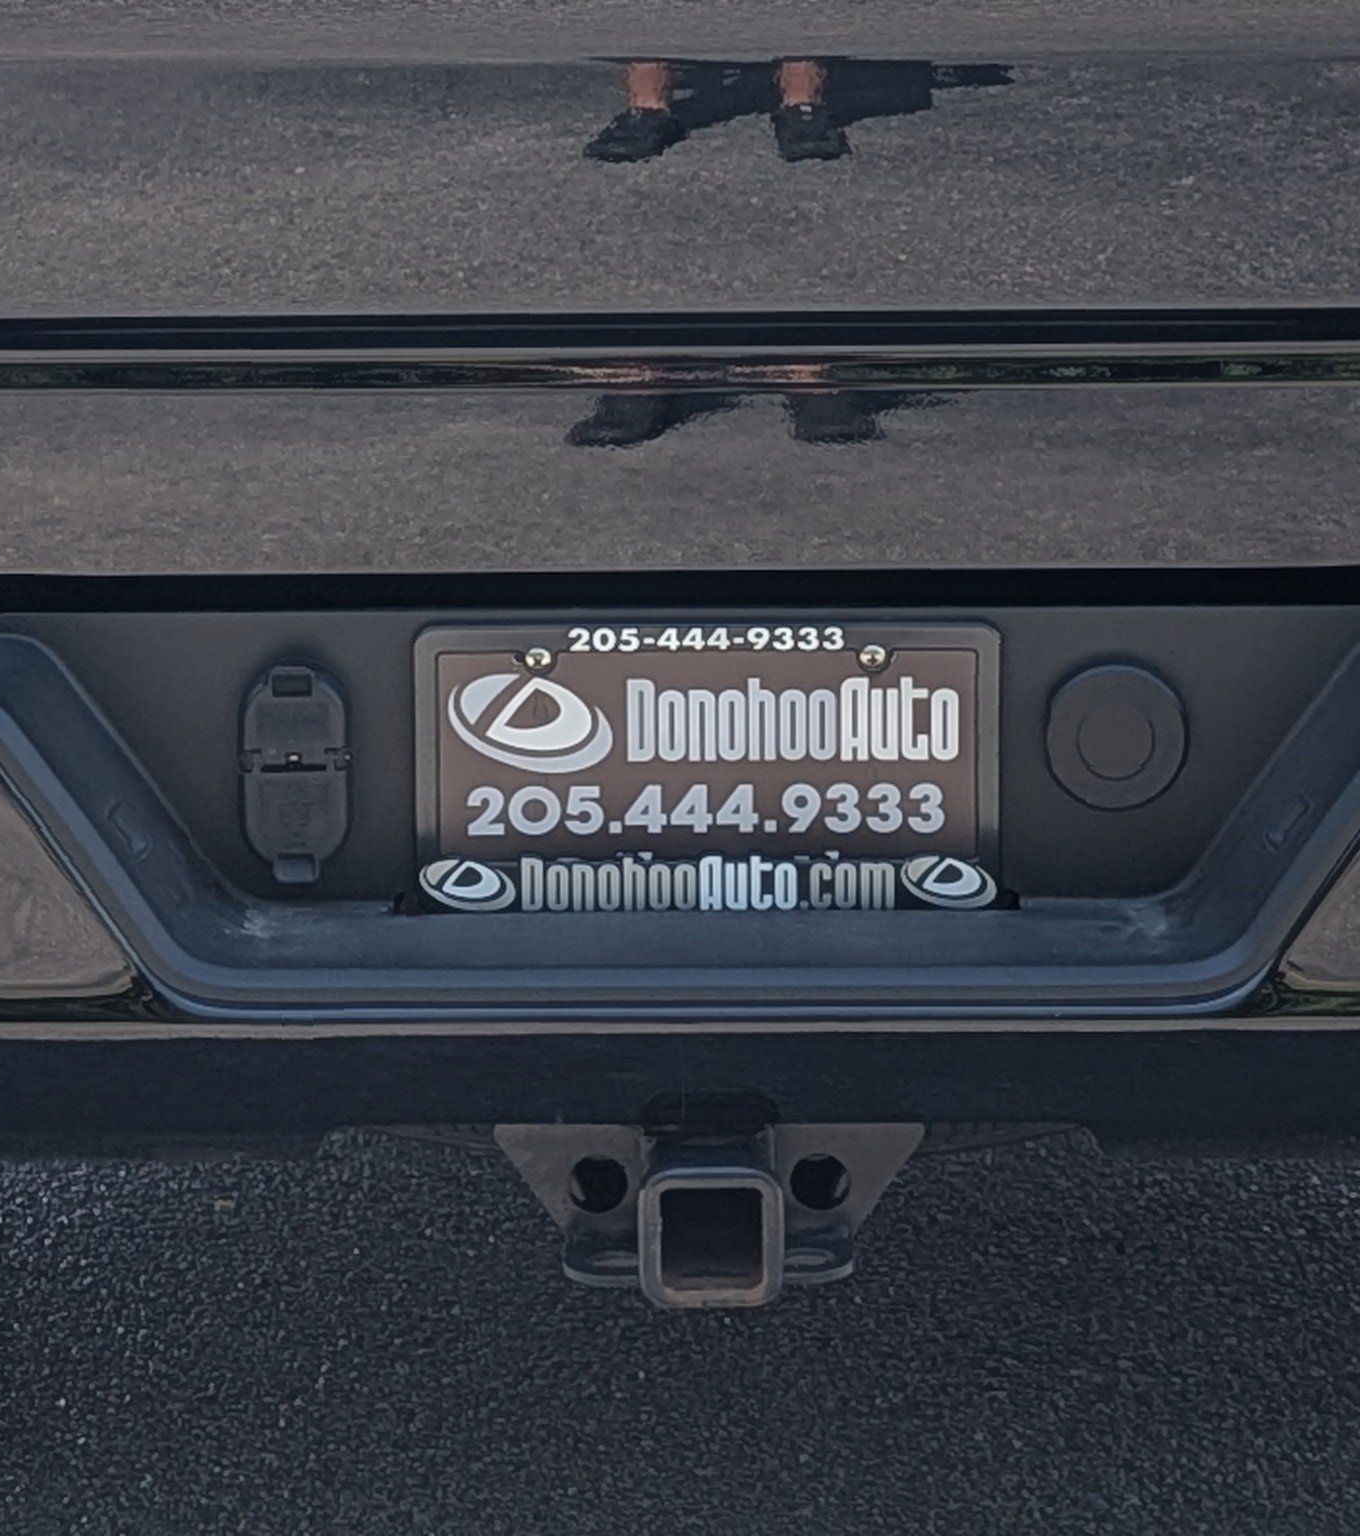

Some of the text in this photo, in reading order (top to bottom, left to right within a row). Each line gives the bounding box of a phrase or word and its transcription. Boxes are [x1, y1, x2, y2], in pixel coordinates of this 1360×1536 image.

[568, 627, 845, 652] 205-444-9333
[467, 783, 946, 836] 205.444.9333
[520, 857, 896, 911] DonohooAuto.com
